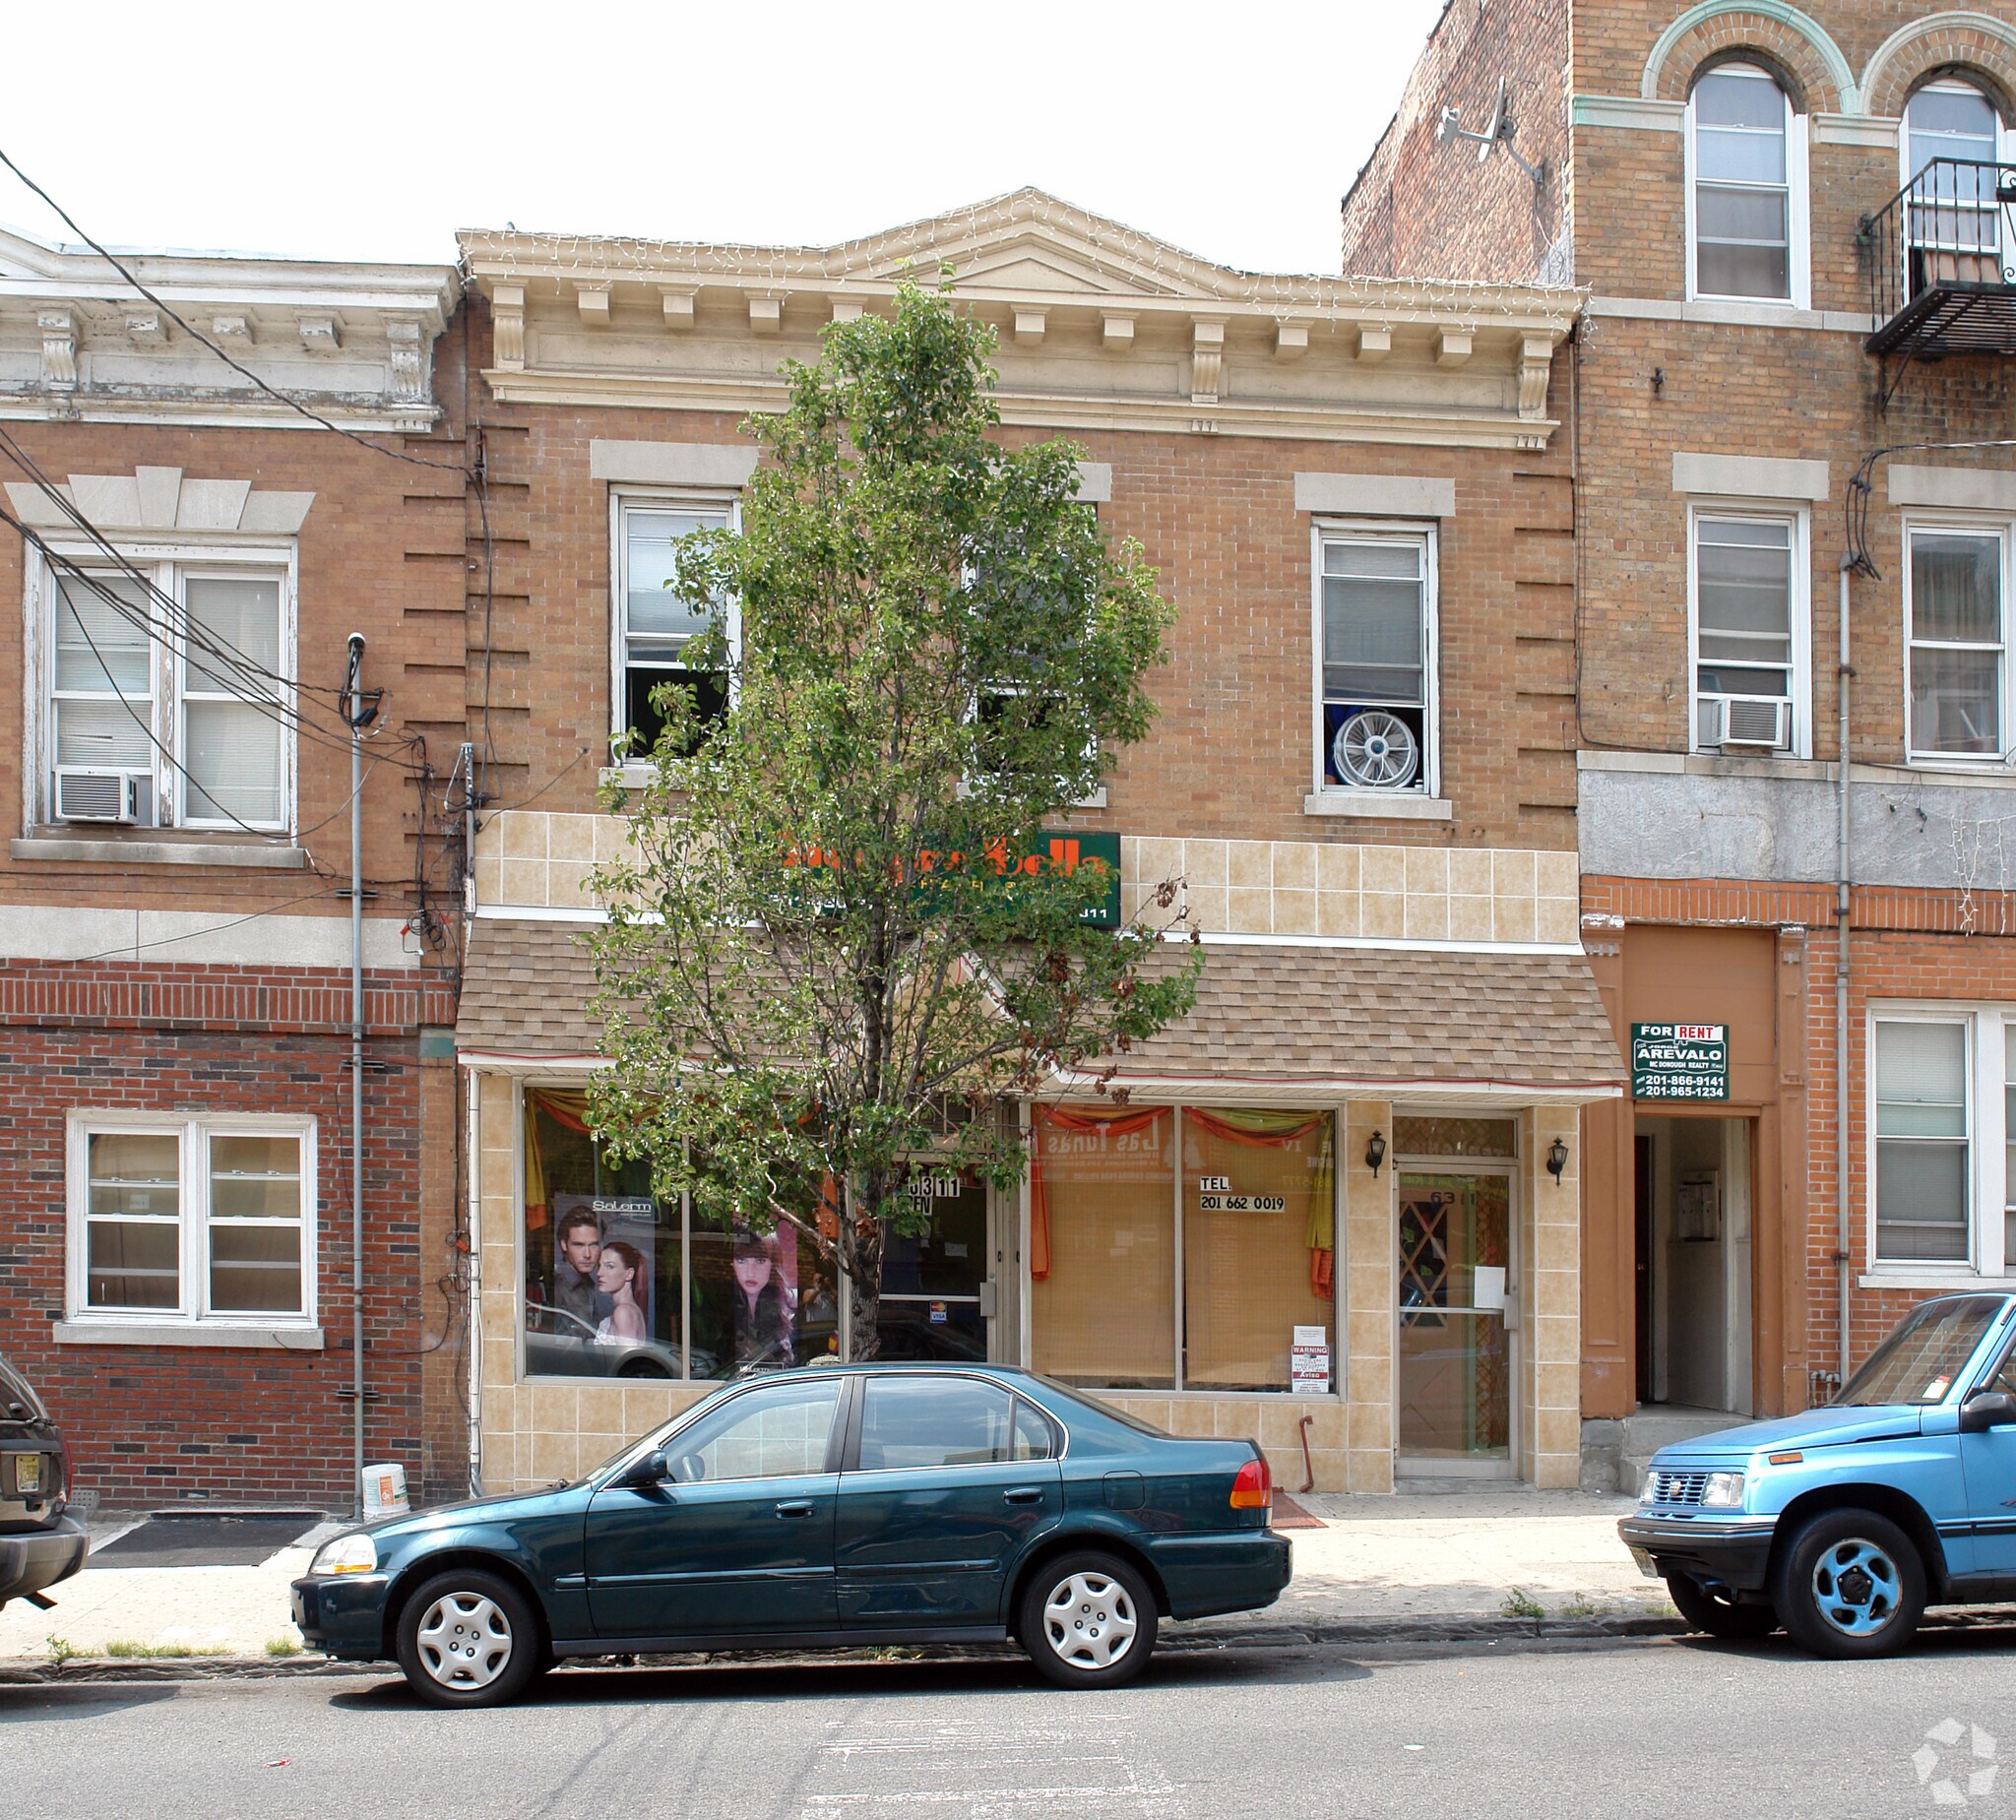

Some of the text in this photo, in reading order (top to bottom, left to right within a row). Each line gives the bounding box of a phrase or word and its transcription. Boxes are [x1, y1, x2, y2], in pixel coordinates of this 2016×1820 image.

[1641, 1026, 1713, 1038] FOR RENT
[1638, 1049, 1721, 1059] AREVALO
[1646, 1075, 1724, 1086] 201-866-9141
[1646, 1086, 1724, 1097] 201-965-1234
[1201, 1177, 1232, 1190] TEL.
[1201, 1196, 1284, 1211] 201 662 0019
